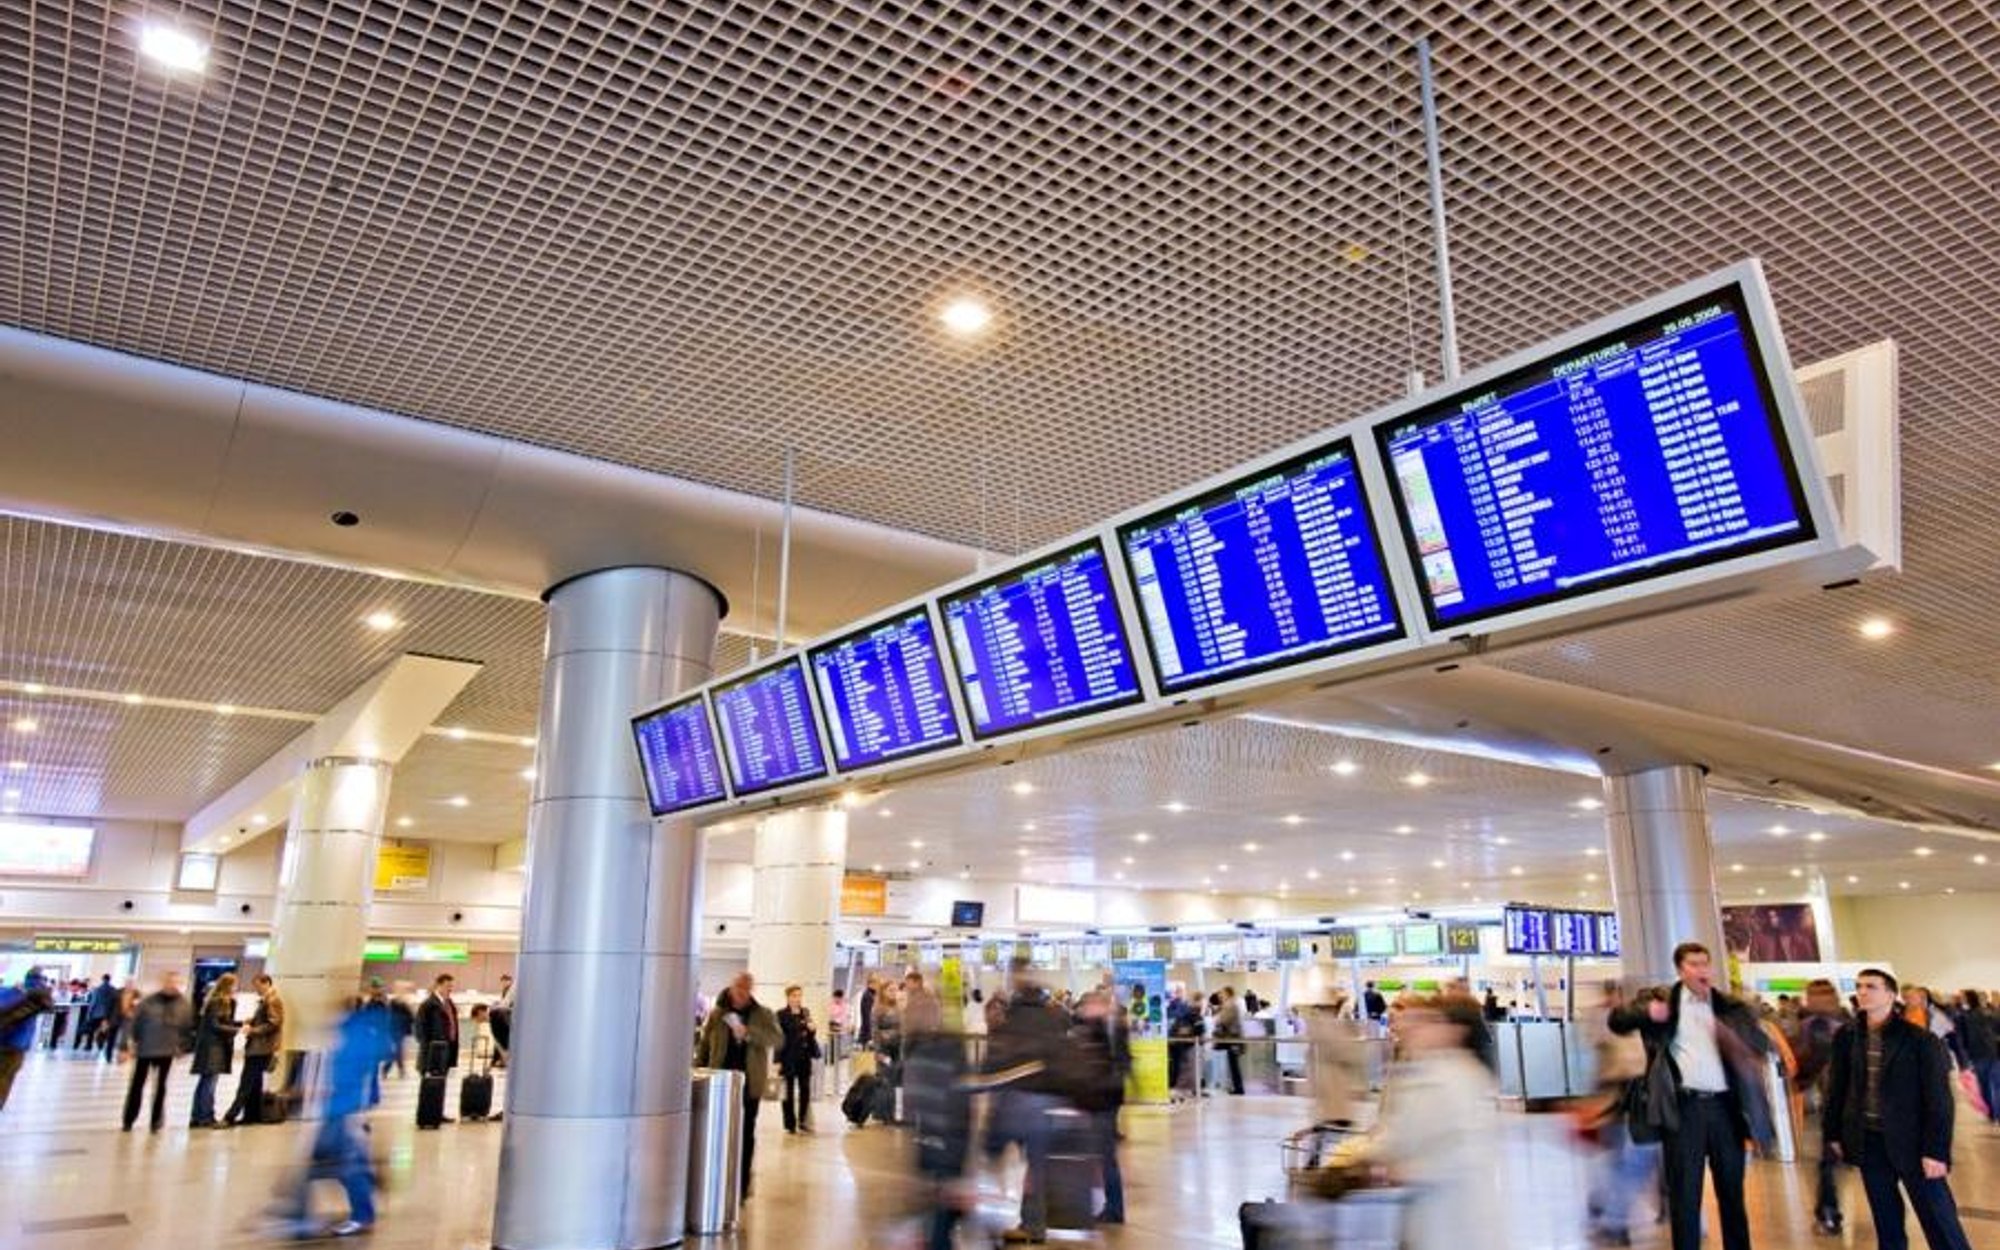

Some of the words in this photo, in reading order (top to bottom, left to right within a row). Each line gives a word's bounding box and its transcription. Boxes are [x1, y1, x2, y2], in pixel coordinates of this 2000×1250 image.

[1552, 341, 1627, 378] DEPARTURES
[1334, 934, 1354, 951] 120
[1451, 929, 1476, 946] 121
